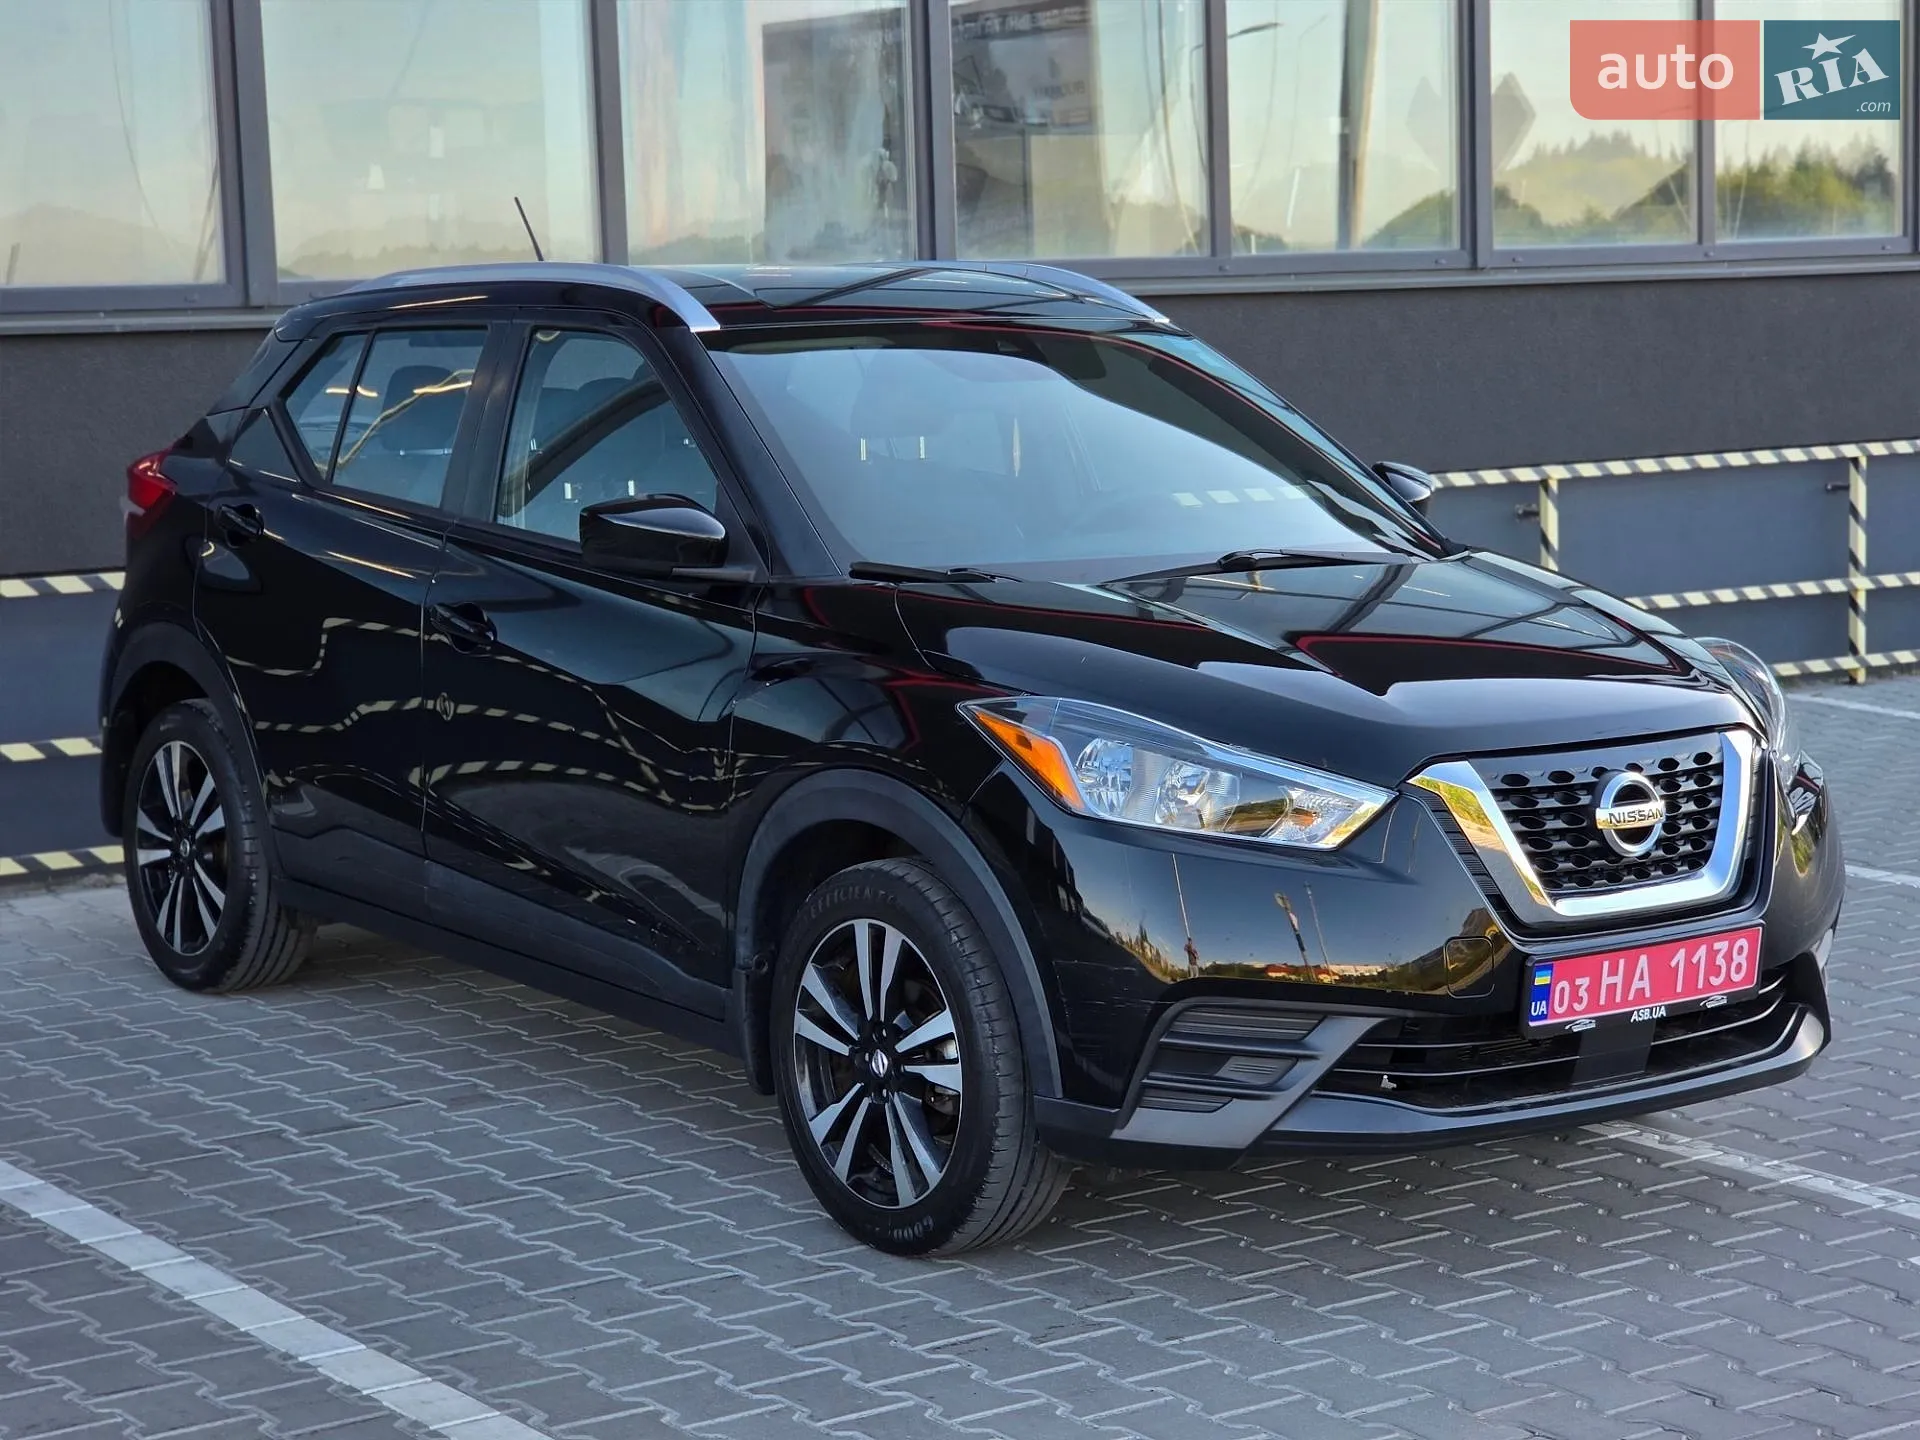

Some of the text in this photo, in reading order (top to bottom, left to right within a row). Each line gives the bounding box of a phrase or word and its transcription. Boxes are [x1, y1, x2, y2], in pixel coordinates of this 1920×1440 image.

[1608, 807, 1664, 824] NISSAN
[1553, 937, 1749, 1014] 03 HA 1138
[1531, 1001, 1548, 1017] UA
[1630, 1005, 1667, 1023] ASB.UA
